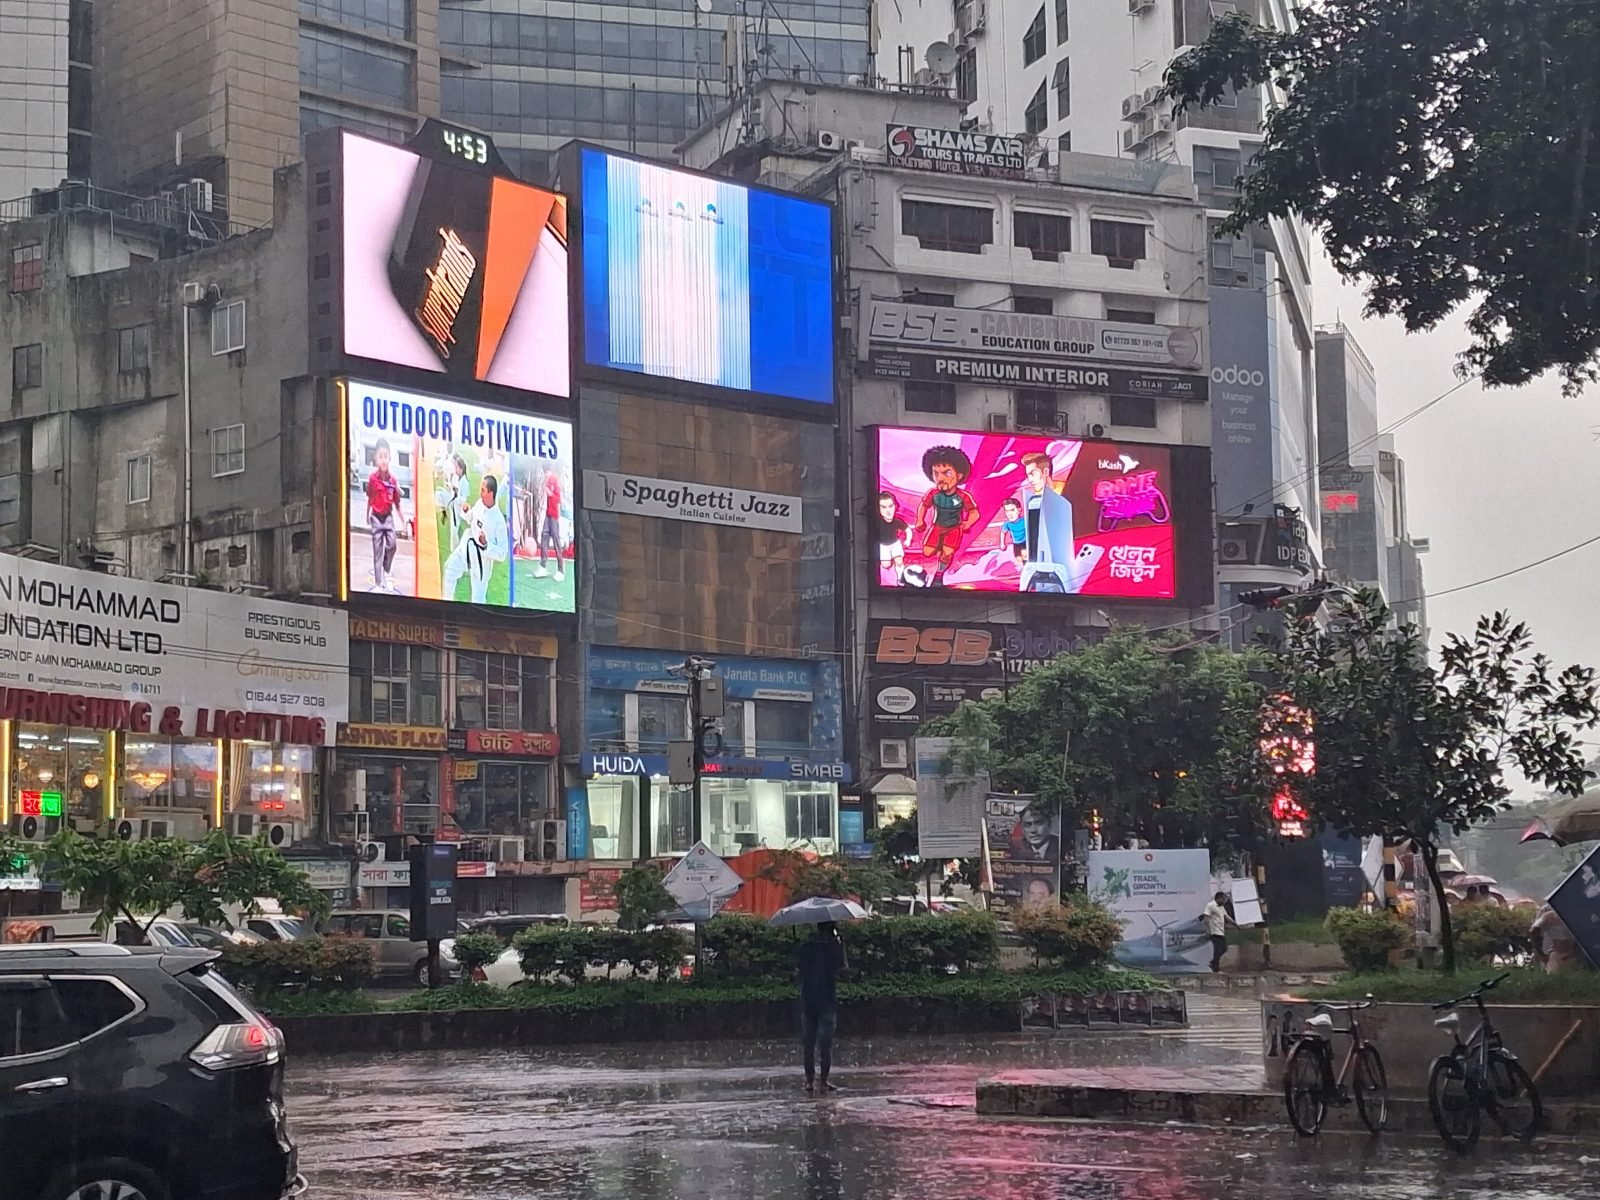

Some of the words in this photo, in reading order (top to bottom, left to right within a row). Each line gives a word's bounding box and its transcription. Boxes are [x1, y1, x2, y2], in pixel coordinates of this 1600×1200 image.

[443, 130, 487, 164] 4:53
[914, 128, 987, 153] SHAMS
[991, 137, 1023, 157] AIR
[921, 147, 953, 161] TOURS
[954, 154, 961, 162] &
[963, 152, 1005, 166] TRAVELS
[1006, 157, 1022, 168] LTD
[868, 305, 958, 344] BSB
[981, 313, 1096, 342] CAMBRIAN
[981, 335, 1050, 351] EDUCATION
[1053, 341, 1095, 355] GROUP
[935, 359, 1020, 380] PREMIUM
[1025, 367, 1110, 387] INTERIOR
[1211, 363, 1264, 387] odoo
[362, 395, 453, 442] OUTDOOR
[461, 414, 559, 460] ACTIVITIES
[1098, 459, 1122, 470] bKash
[622, 479, 734, 511] Spaghetti
[740, 494, 791, 518] Jazz
[679, 507, 711, 520] Italian
[713, 511, 747, 524] Cuisine
[1108, 545, 1157, 566] খেলুন
[1109, 561, 1160, 583] জিতুন
[18, 575, 181, 624] MOHAMMAD
[248, 612, 321, 631] PRESTIGIOUS
[398, 623, 437, 642] SUPER
[118, 629, 168, 656] LTD.
[244, 627, 301, 644] BUSINESS
[303, 636, 327, 647] HUB
[876, 625, 992, 666] BSB
[19, 650, 33, 662] OF
[35, 653, 59, 666] AMIN
[61, 657, 122, 674] MOHAMMAD
[124, 663, 162, 677] GROUP
[236, 649, 294, 682] Coming
[296, 668, 329, 682] soon
[724, 667, 757, 681] Janata
[760, 670, 785, 682] Bank
[245, 690, 278, 702] 01844
[280, 695, 300, 705] 527
[159, 705, 184, 736] &
[195, 707, 327, 747] LIGHTING
[401, 730, 448, 748] PLAZA
[478, 731, 513, 750] টাচি
[593, 755, 647, 774] HUIDA
